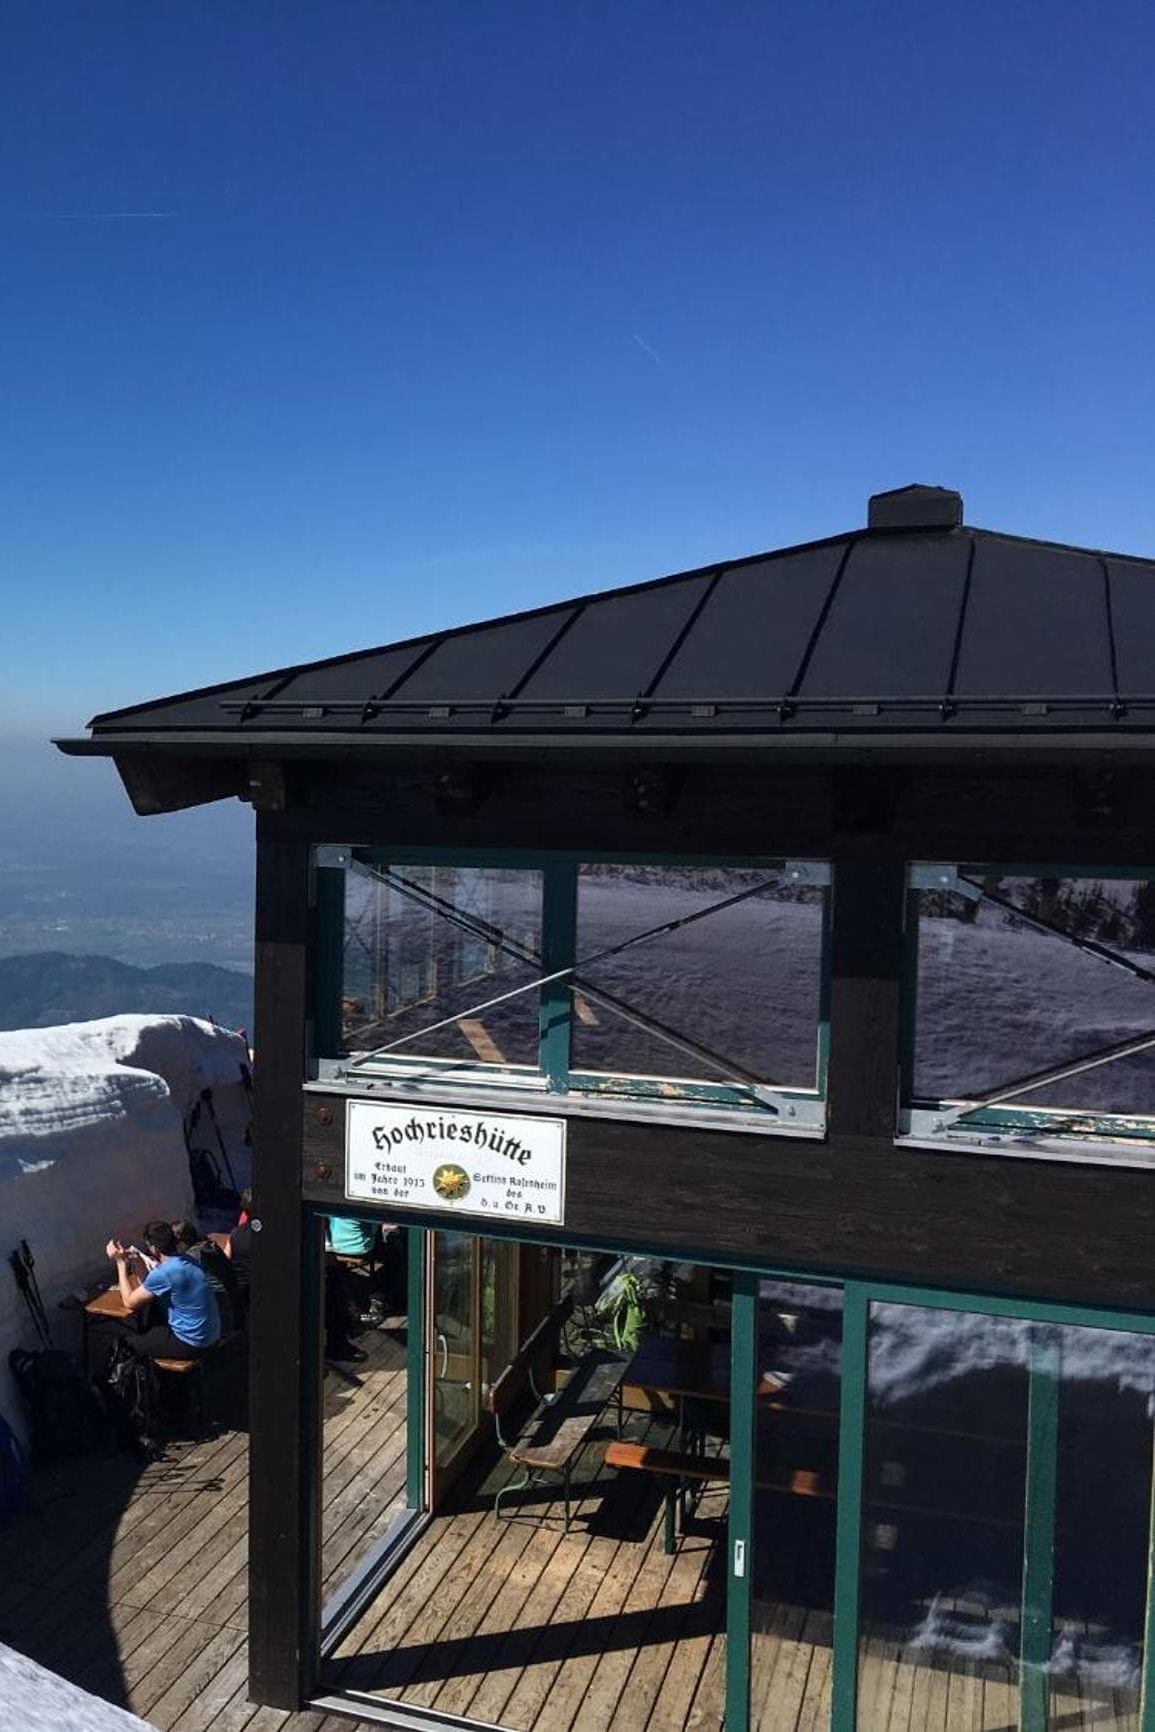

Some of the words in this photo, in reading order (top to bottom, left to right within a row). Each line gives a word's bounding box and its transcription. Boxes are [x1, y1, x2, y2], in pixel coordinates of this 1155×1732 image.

[372, 1116, 532, 1166] Hochrieshütte
[374, 1162, 407, 1174] Erbaut
[371, 1173, 398, 1185] Jahre
[509, 1176, 557, 1190] Rosenheim
[372, 1187, 389, 1196] von
[393, 1188, 410, 1198] der
[506, 1188, 523, 1198] des
